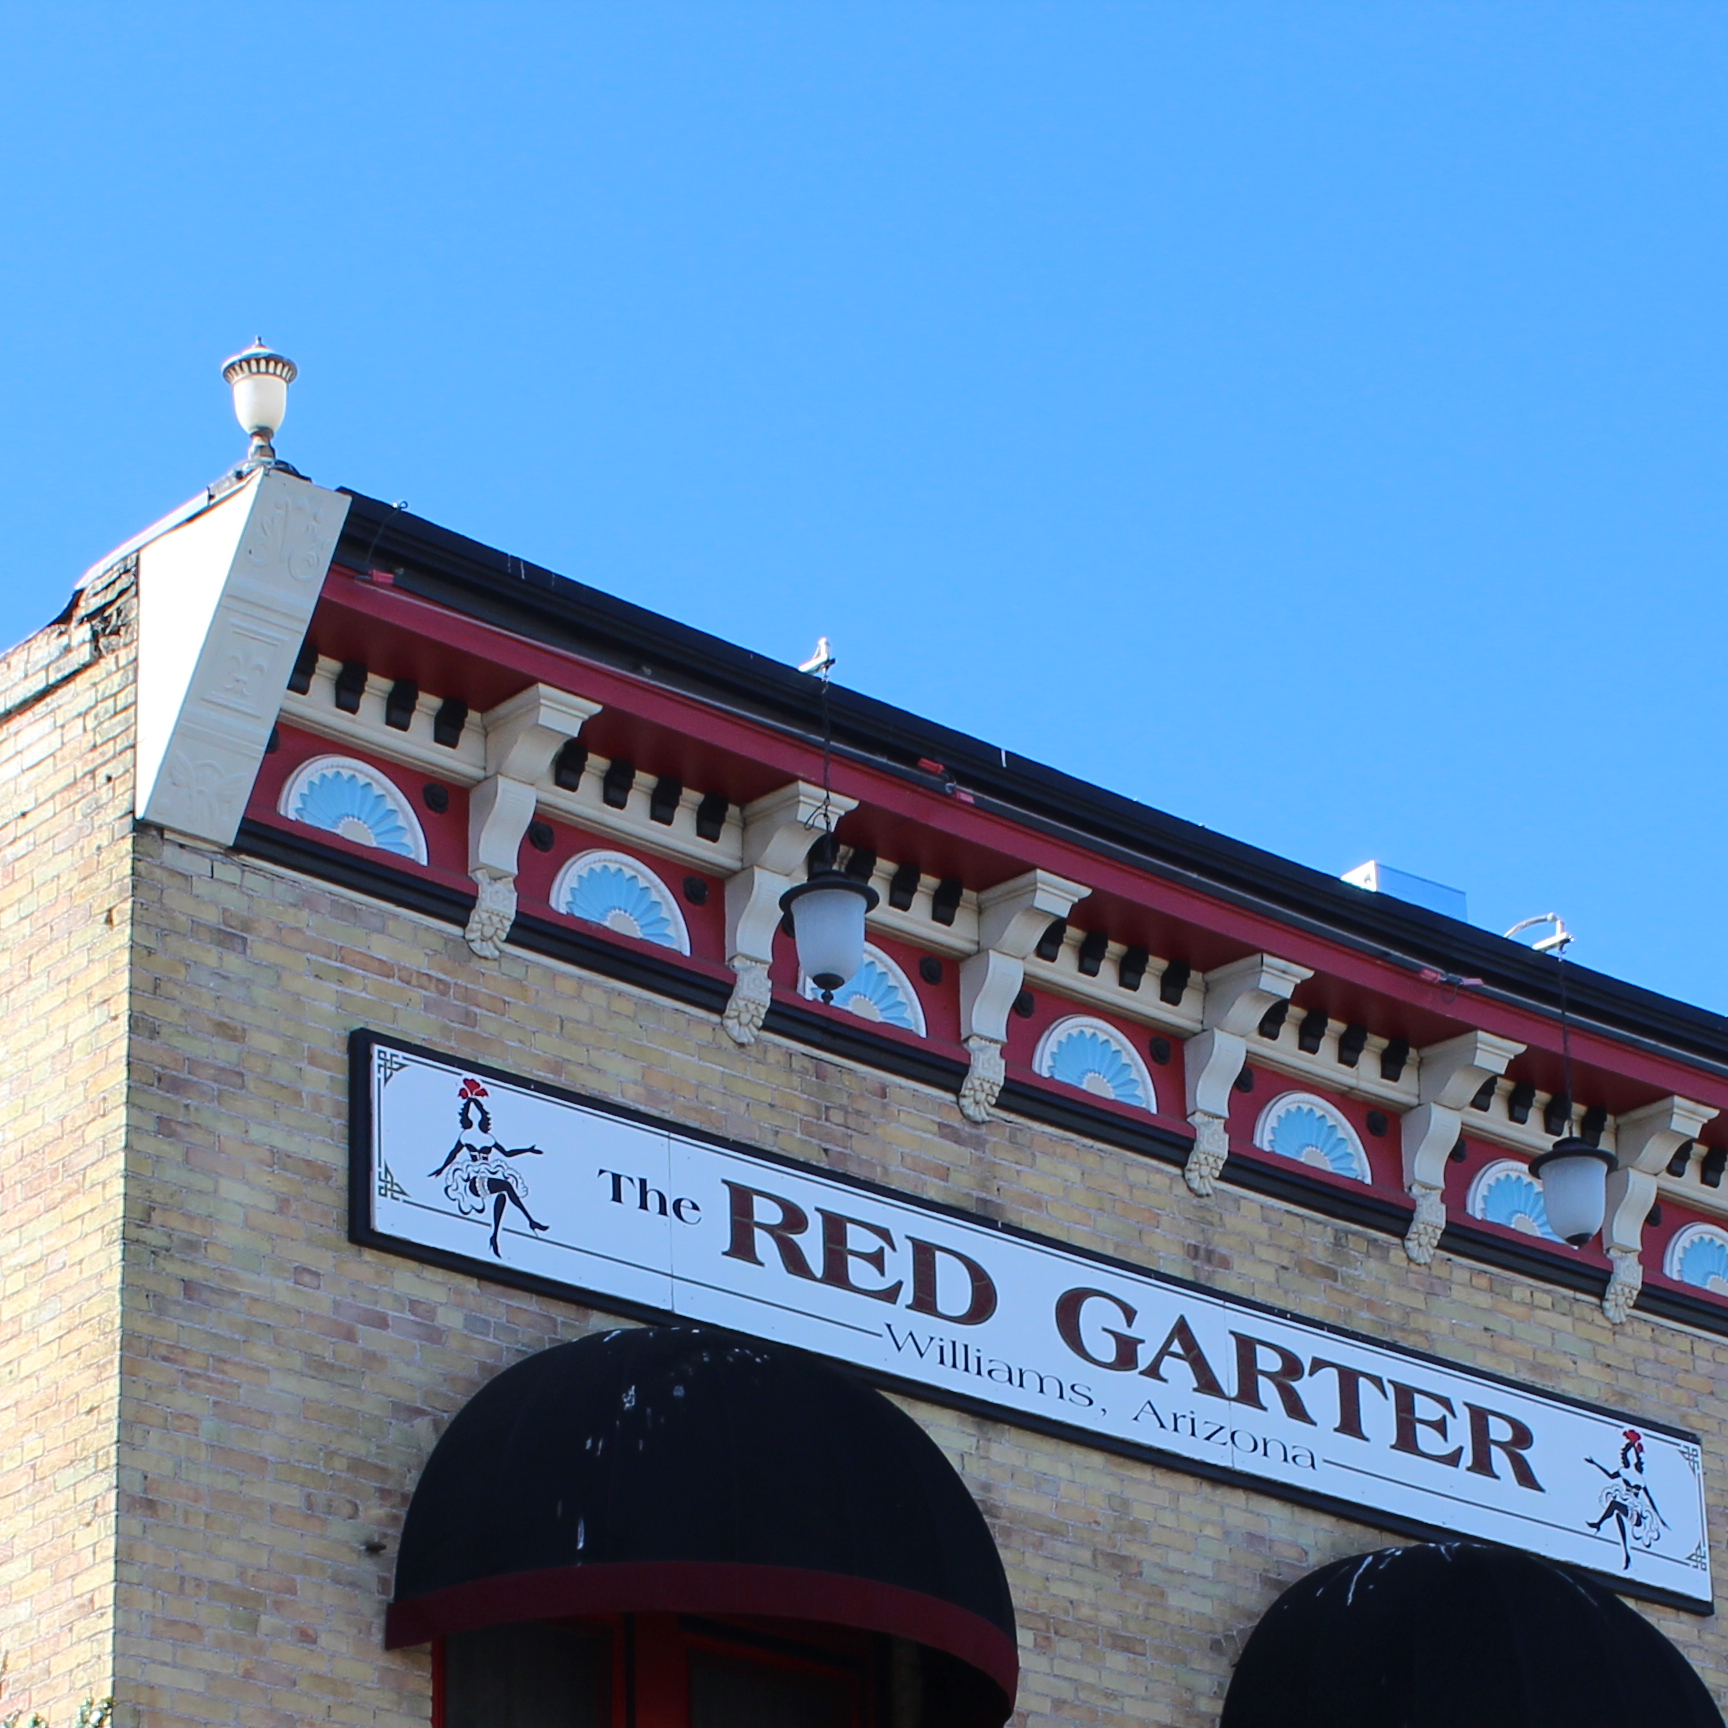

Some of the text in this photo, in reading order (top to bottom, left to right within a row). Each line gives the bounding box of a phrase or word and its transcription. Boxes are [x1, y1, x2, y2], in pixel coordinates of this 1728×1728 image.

[597, 1168, 1547, 1494] The RED GARTER
[884, 1322, 1319, 1472] Williams, Arizona
